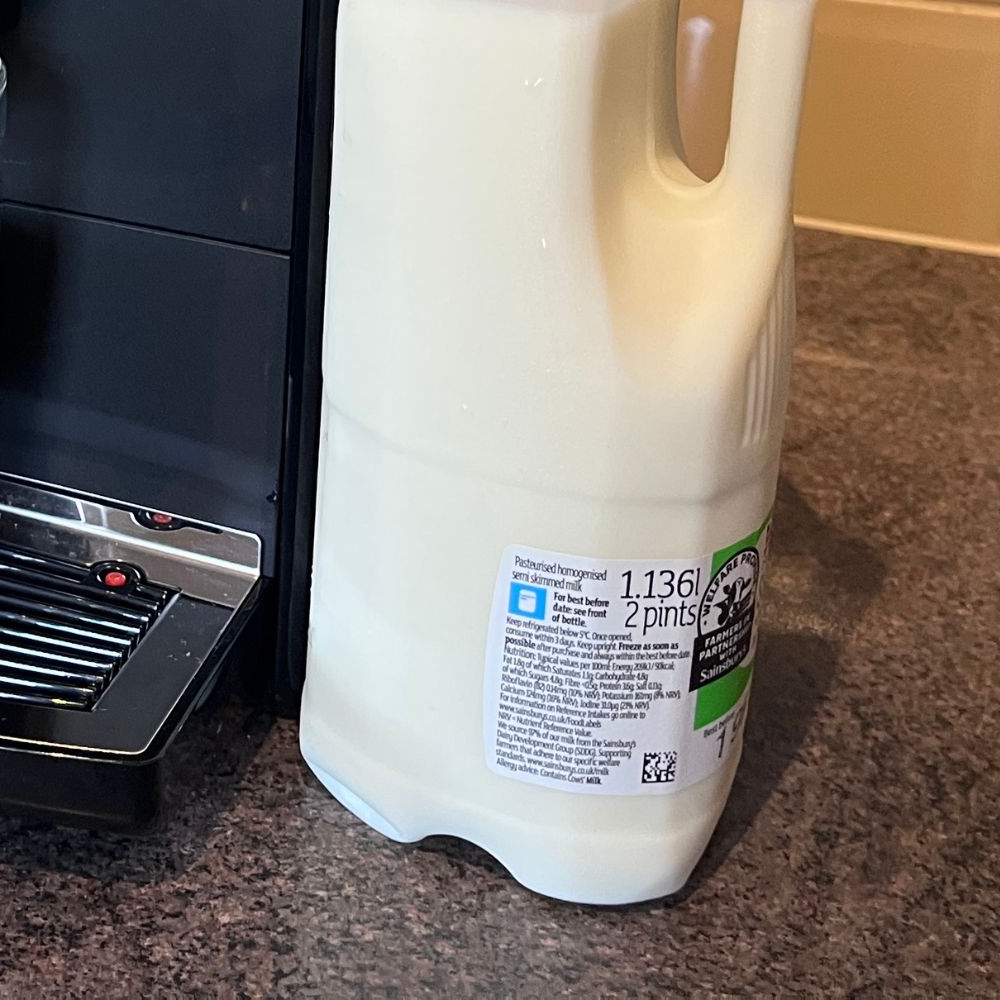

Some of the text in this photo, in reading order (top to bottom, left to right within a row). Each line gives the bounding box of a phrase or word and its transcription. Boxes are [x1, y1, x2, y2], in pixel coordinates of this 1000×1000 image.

[514, 554, 607, 582] Pasteurised homogenised
[512, 570, 583, 592] semi skimmed milk
[702, 557, 739, 618] WELFARE
[553, 591, 610, 608] For best before
[551, 613, 587, 627] of bottle.
[573, 608, 587, 617] see
[587, 608, 607, 619] front
[625, 599, 697, 636] 2 pints
[505, 626, 533, 640] consume
[533, 632, 555, 644] within
[577, 639, 593, 651] Keep
[617, 641, 642, 651] Freeze
[642, 643, 652, 651] as
[652, 643, 670, 651] soon
[670, 642, 680, 650] as
[506, 616, 522, 628] Keep
[522, 620, 559, 635] refrigerated
[559, 626, 579, 638] below
[591, 632, 608, 641] Once
[504, 635, 536, 650] possible
[536, 642, 551, 653] after
[551, 646, 581, 659] purchase
[580, 650, 594, 660] and
[503, 654, 513, 664] Fat
[532, 662, 552, 673] which
[509, 667, 528, 677] which
[559, 657, 580, 669] values
[580, 661, 592, 672] per
[500, 691, 510, 702] For
[509, 695, 547, 711] information
[546, 703, 556, 712] on
[610, 711, 620, 722] go
[619, 709, 639, 720] online
[639, 710, 647, 720] to
[496, 728, 513, 743] Dairy
[513, 733, 555, 750] Development
[555, 742, 575, 755] Group
[597, 747, 633, 760] Supporting
[497, 719, 509, 730] We
[508, 723, 529, 735] source
[541, 730, 550, 740] of
[549, 733, 561, 742] our
[560, 735, 575, 745] milk
[575, 736, 592, 747] from
[591, 738, 603, 747] the
[496, 738, 519, 752] farmers
[519, 744, 533, 755] that
[532, 748, 555, 760] adhere
[561, 755, 574, 764] our
[496, 756, 518, 772] Allergy
[539, 768, 568, 782] Contains
